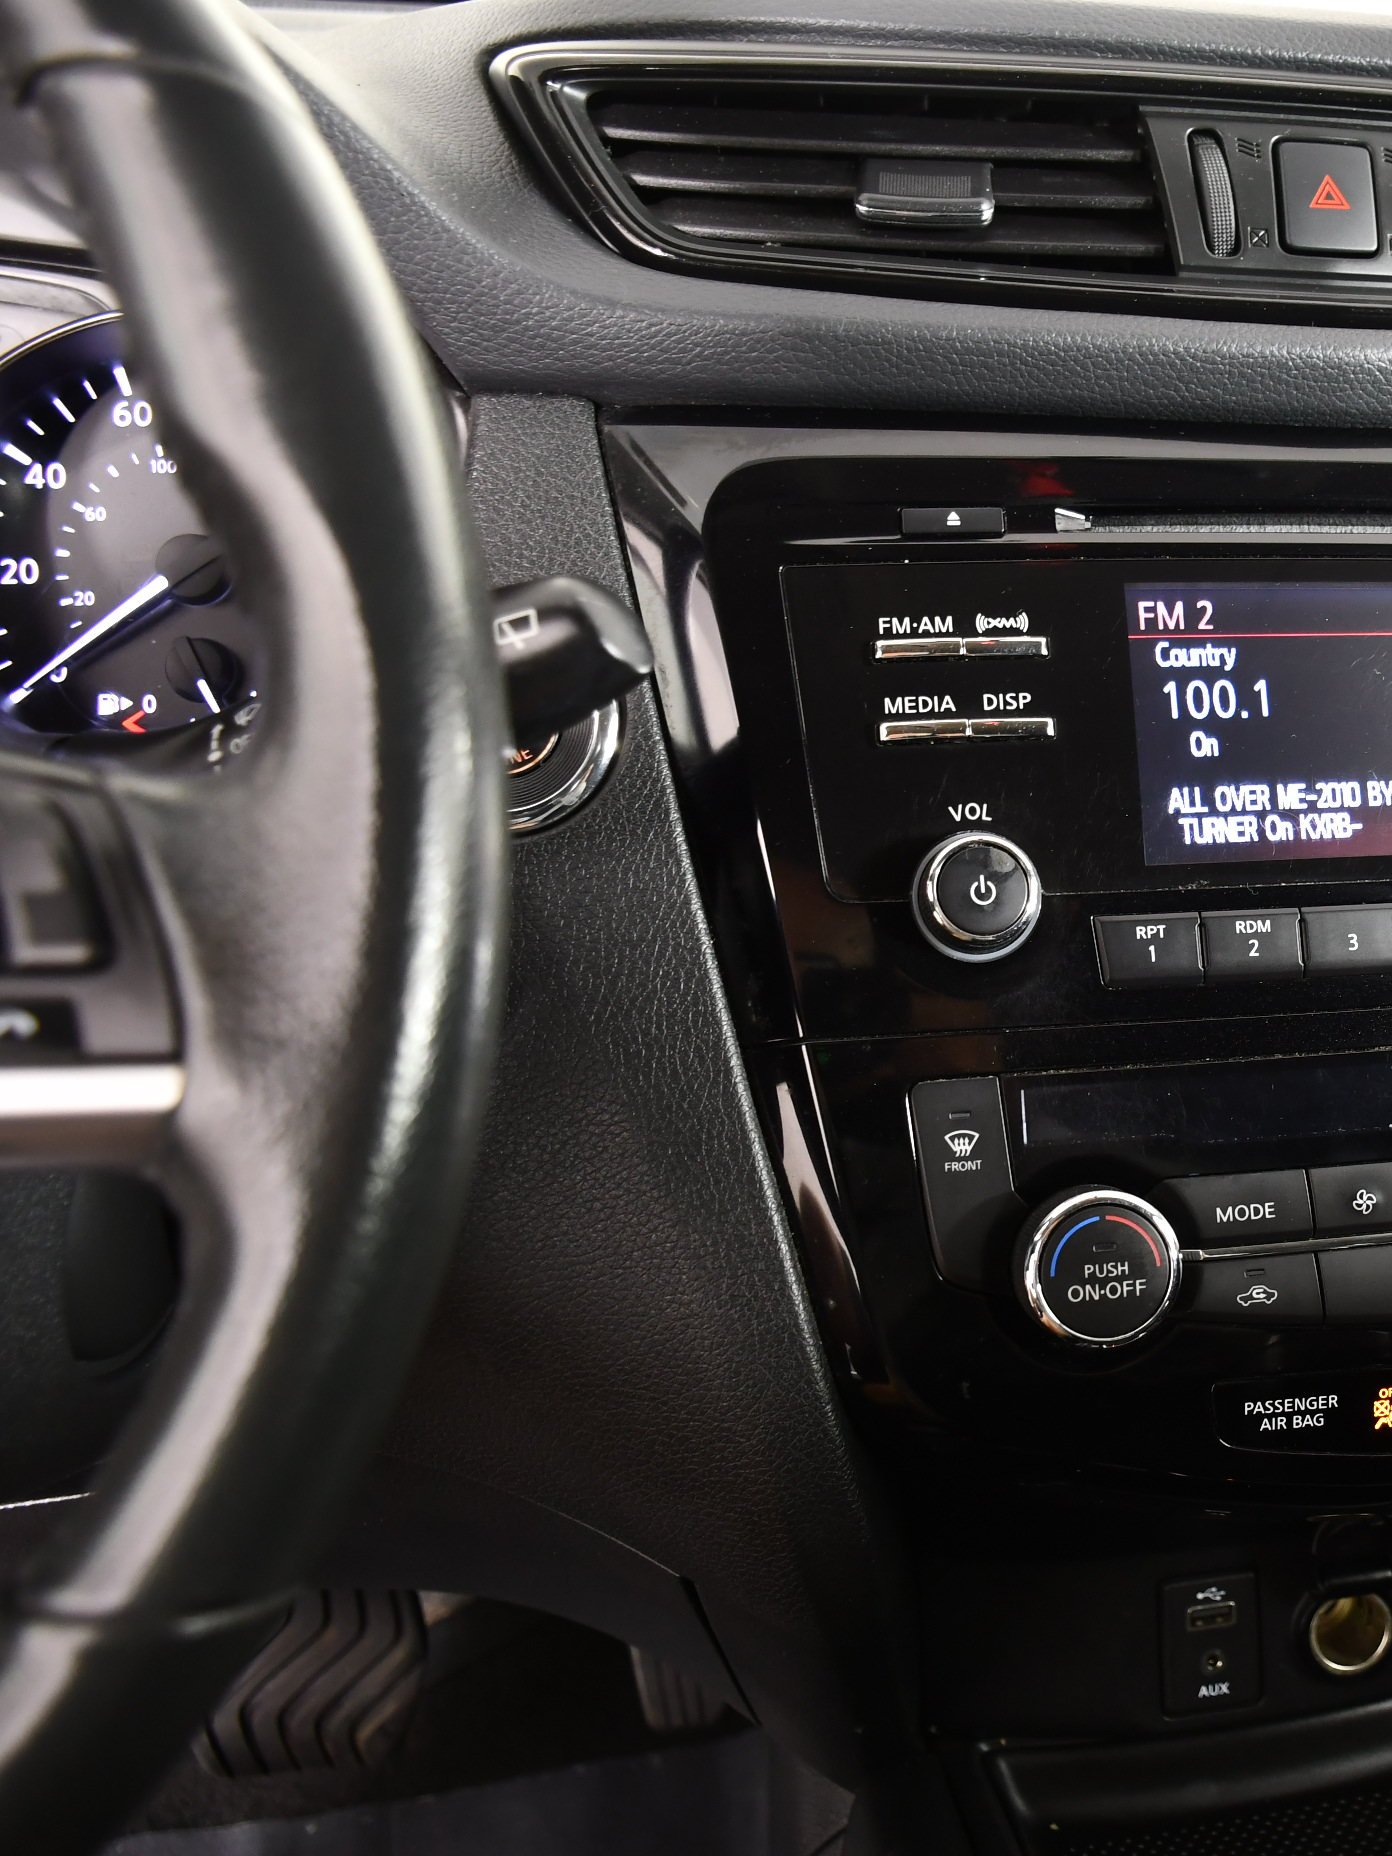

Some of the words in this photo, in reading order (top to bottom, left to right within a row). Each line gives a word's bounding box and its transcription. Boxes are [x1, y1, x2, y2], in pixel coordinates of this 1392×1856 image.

[111, 400, 152, 427] 60
[151, 459, 177, 474] 100
[25, 463, 66, 489] 40
[84, 506, 107, 521] 60
[0, 557, 39, 585] 20
[74, 591, 95, 606] 20
[1138, 601, 1184, 630] FM
[1197, 600, 1213, 629] 2
[1155, 641, 1236, 671] Country
[142, 694, 157, 714] 0
[885, 696, 956, 714] MEDIA
[983, 693, 1031, 710] DISP
[1163, 679, 1269, 719] 100.1
[1190, 731, 1219, 757] On
[1168, 787, 1208, 814] ALL
[1215, 784, 1271, 812] OVER
[1277, 782, 1361, 809] ME-2010
[948, 803, 992, 821] VOL
[1178, 815, 1259, 845] TURNER
[1265, 818, 1294, 842] On
[1136, 925, 1166, 939] RPT
[1236, 920, 1271, 933] RDM
[1249, 940, 1259, 956] 2
[1348, 934, 1358, 950] 3
[1149, 945, 1155, 962] 1
[945, 1160, 981, 1171] FRONT
[1216, 1202, 1275, 1222] MODE
[1085, 1262, 1128, 1278] PUSH
[1244, 1395, 1338, 1416] PASSENGER
[1260, 1417, 1286, 1431] AIR
[1293, 1413, 1325, 1429] BAG
[1198, 1682, 1230, 1698] AUX
